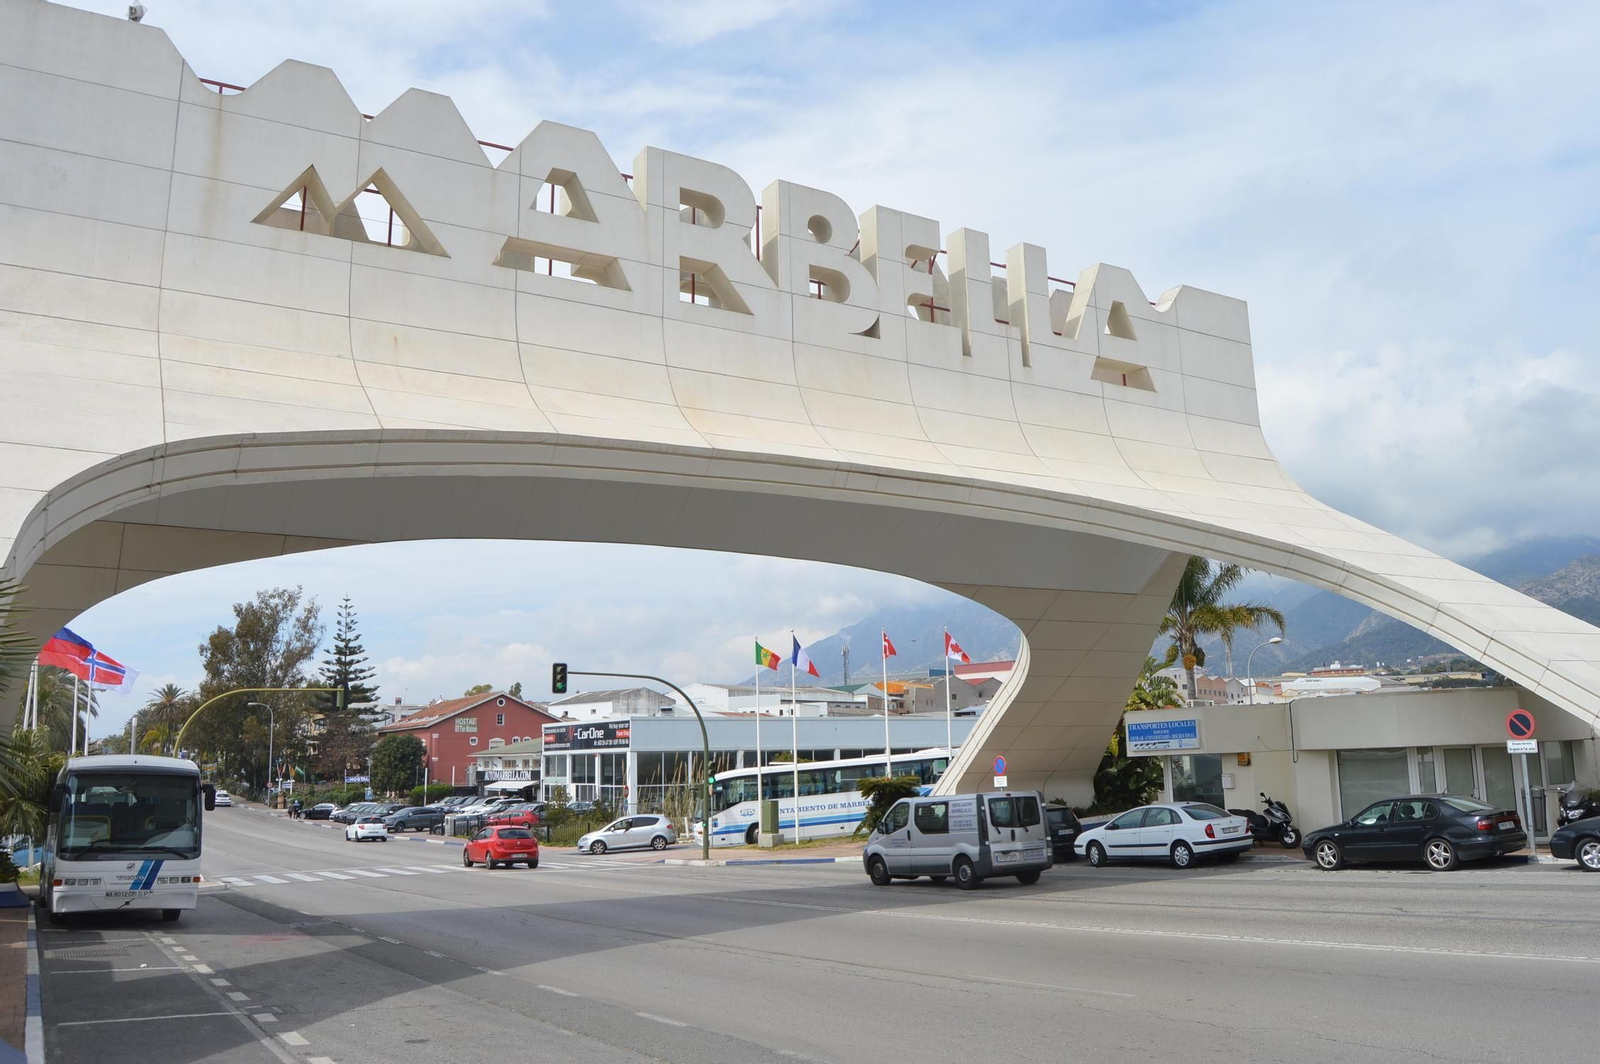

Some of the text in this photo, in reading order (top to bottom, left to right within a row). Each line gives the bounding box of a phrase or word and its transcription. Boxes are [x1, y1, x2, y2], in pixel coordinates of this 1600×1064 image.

[222, 60, 1172, 393] MARBELLA
[1129, 720, 1195, 731] TRANSPORTES LOCALES
